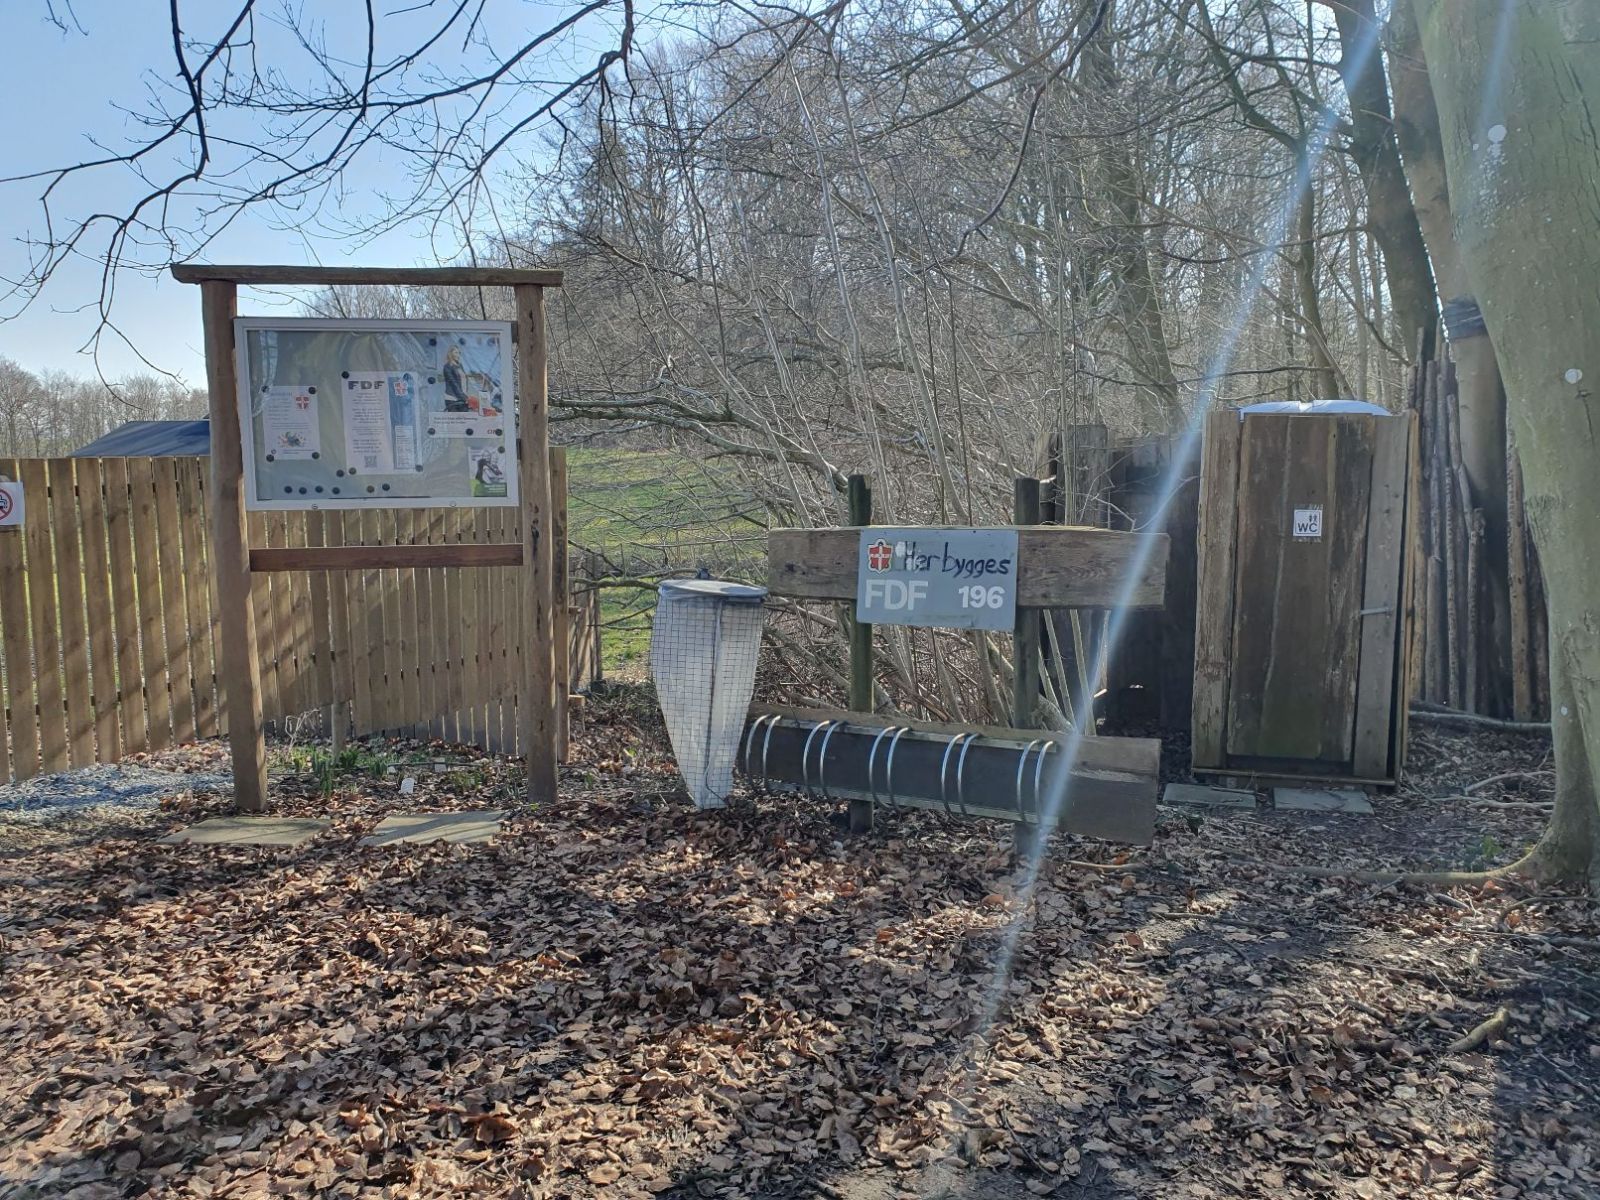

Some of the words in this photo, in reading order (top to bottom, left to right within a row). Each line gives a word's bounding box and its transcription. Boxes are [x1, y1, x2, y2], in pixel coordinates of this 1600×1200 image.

[347, 381, 385, 390] FDF
[1297, 522, 1318, 533] WC
[904, 540, 940, 571] Her
[942, 541, 1011, 579] bygges
[864, 579, 929, 611] FDF
[958, 585, 1006, 609] 196
